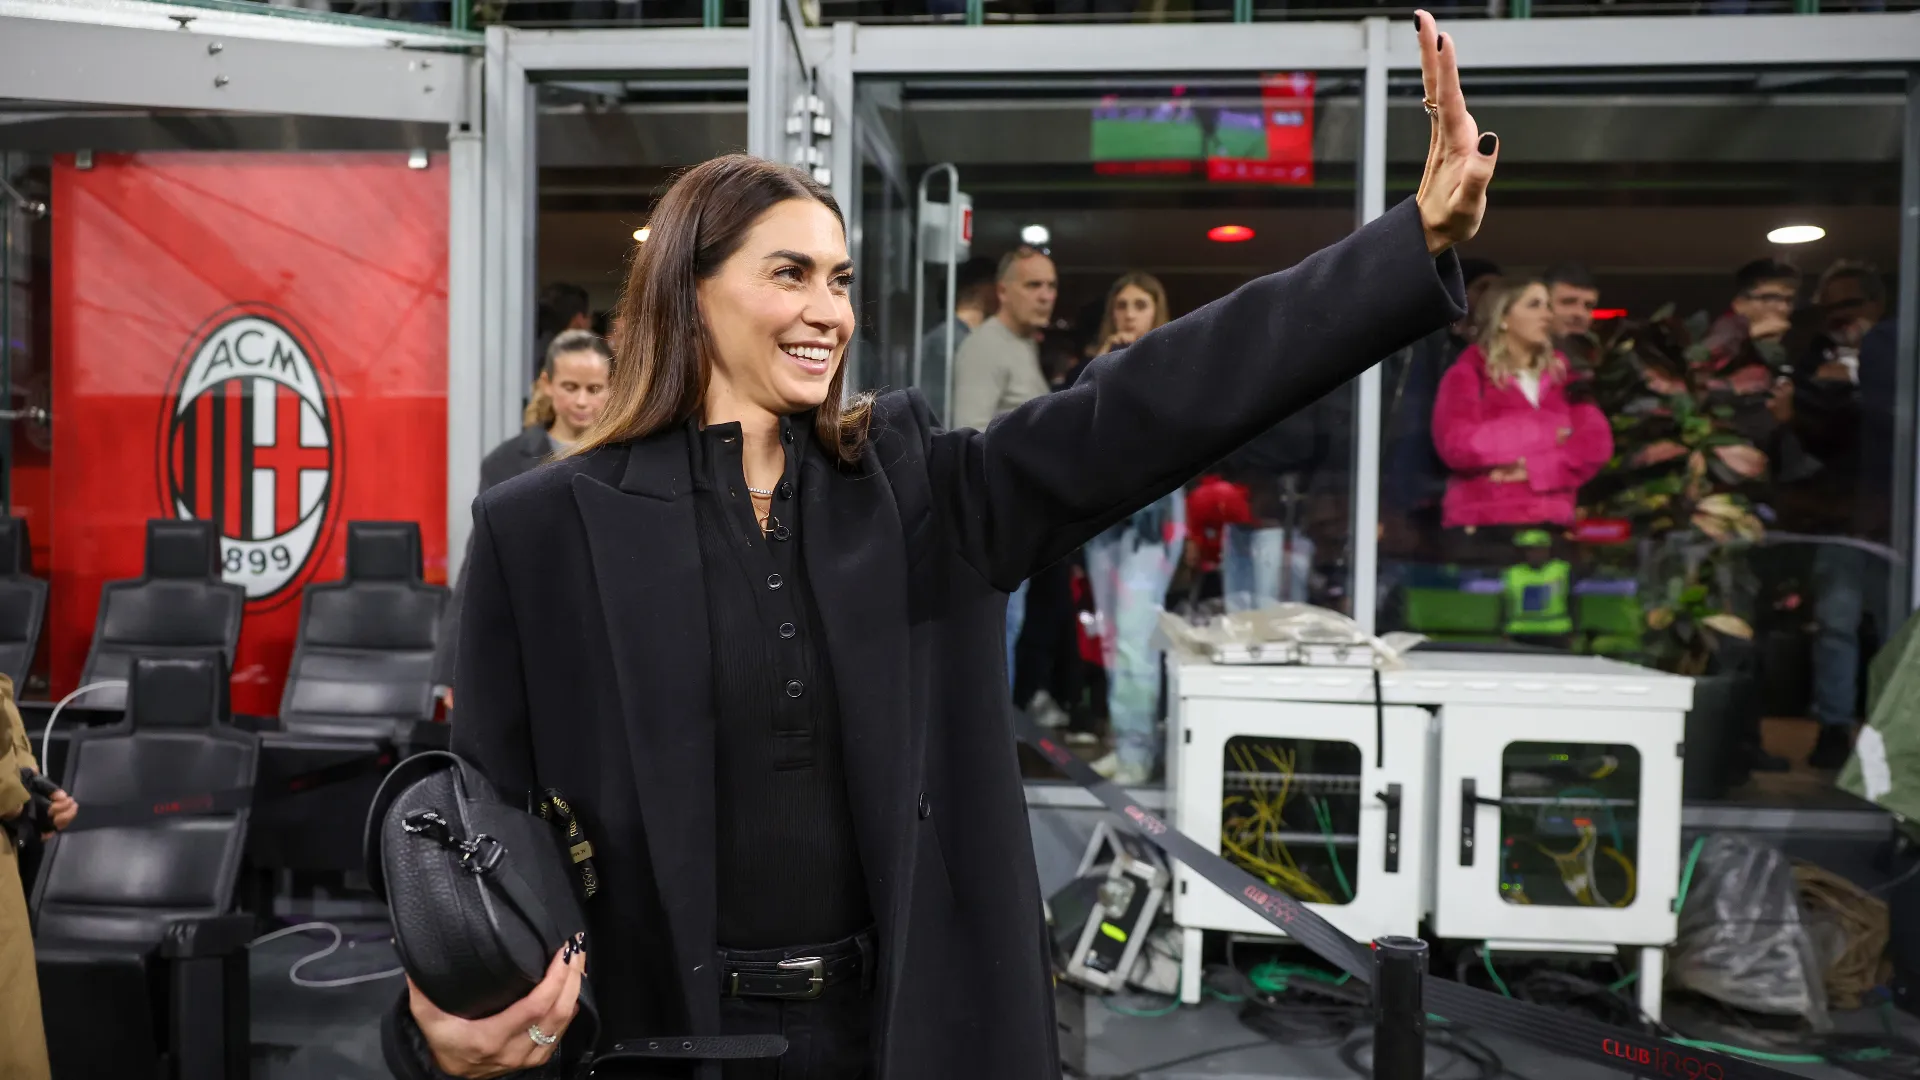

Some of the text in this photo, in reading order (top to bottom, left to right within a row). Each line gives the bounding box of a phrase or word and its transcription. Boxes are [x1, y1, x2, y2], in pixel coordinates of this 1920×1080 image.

[201, 330, 301, 381] ACM
[224, 544, 292, 575] 899
[553, 796, 571, 813] ROW
[1602, 1039, 1651, 1065] CLUB
